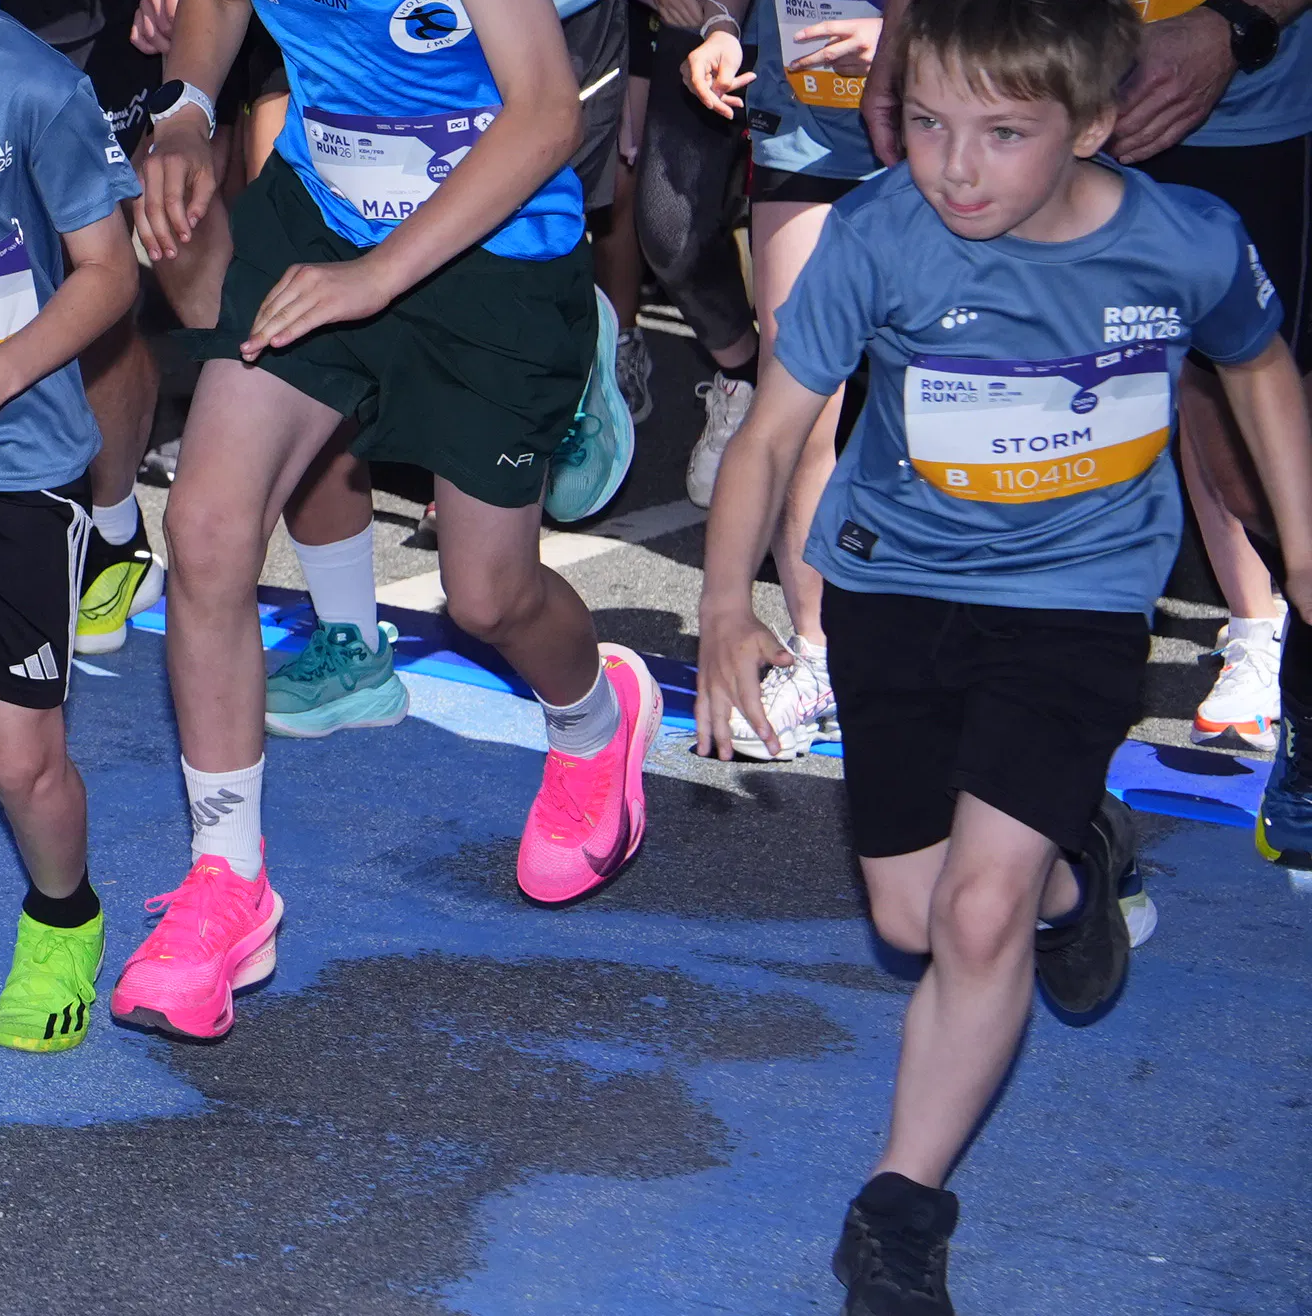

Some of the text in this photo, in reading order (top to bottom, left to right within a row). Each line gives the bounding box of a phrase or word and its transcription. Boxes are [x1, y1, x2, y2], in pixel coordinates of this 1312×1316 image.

[803, 75, 818, 93] B
[449, 120, 467, 130] DGI
[322, 132, 351, 146] OYAL
[429, 164, 450, 172] one
[1103, 305, 1182, 324] ROYAL
[920, 378, 978, 392] ROYAL
[991, 427, 1093, 455] STORM
[944, 468, 970, 487] B
[990, 457, 1097, 491] 110410
